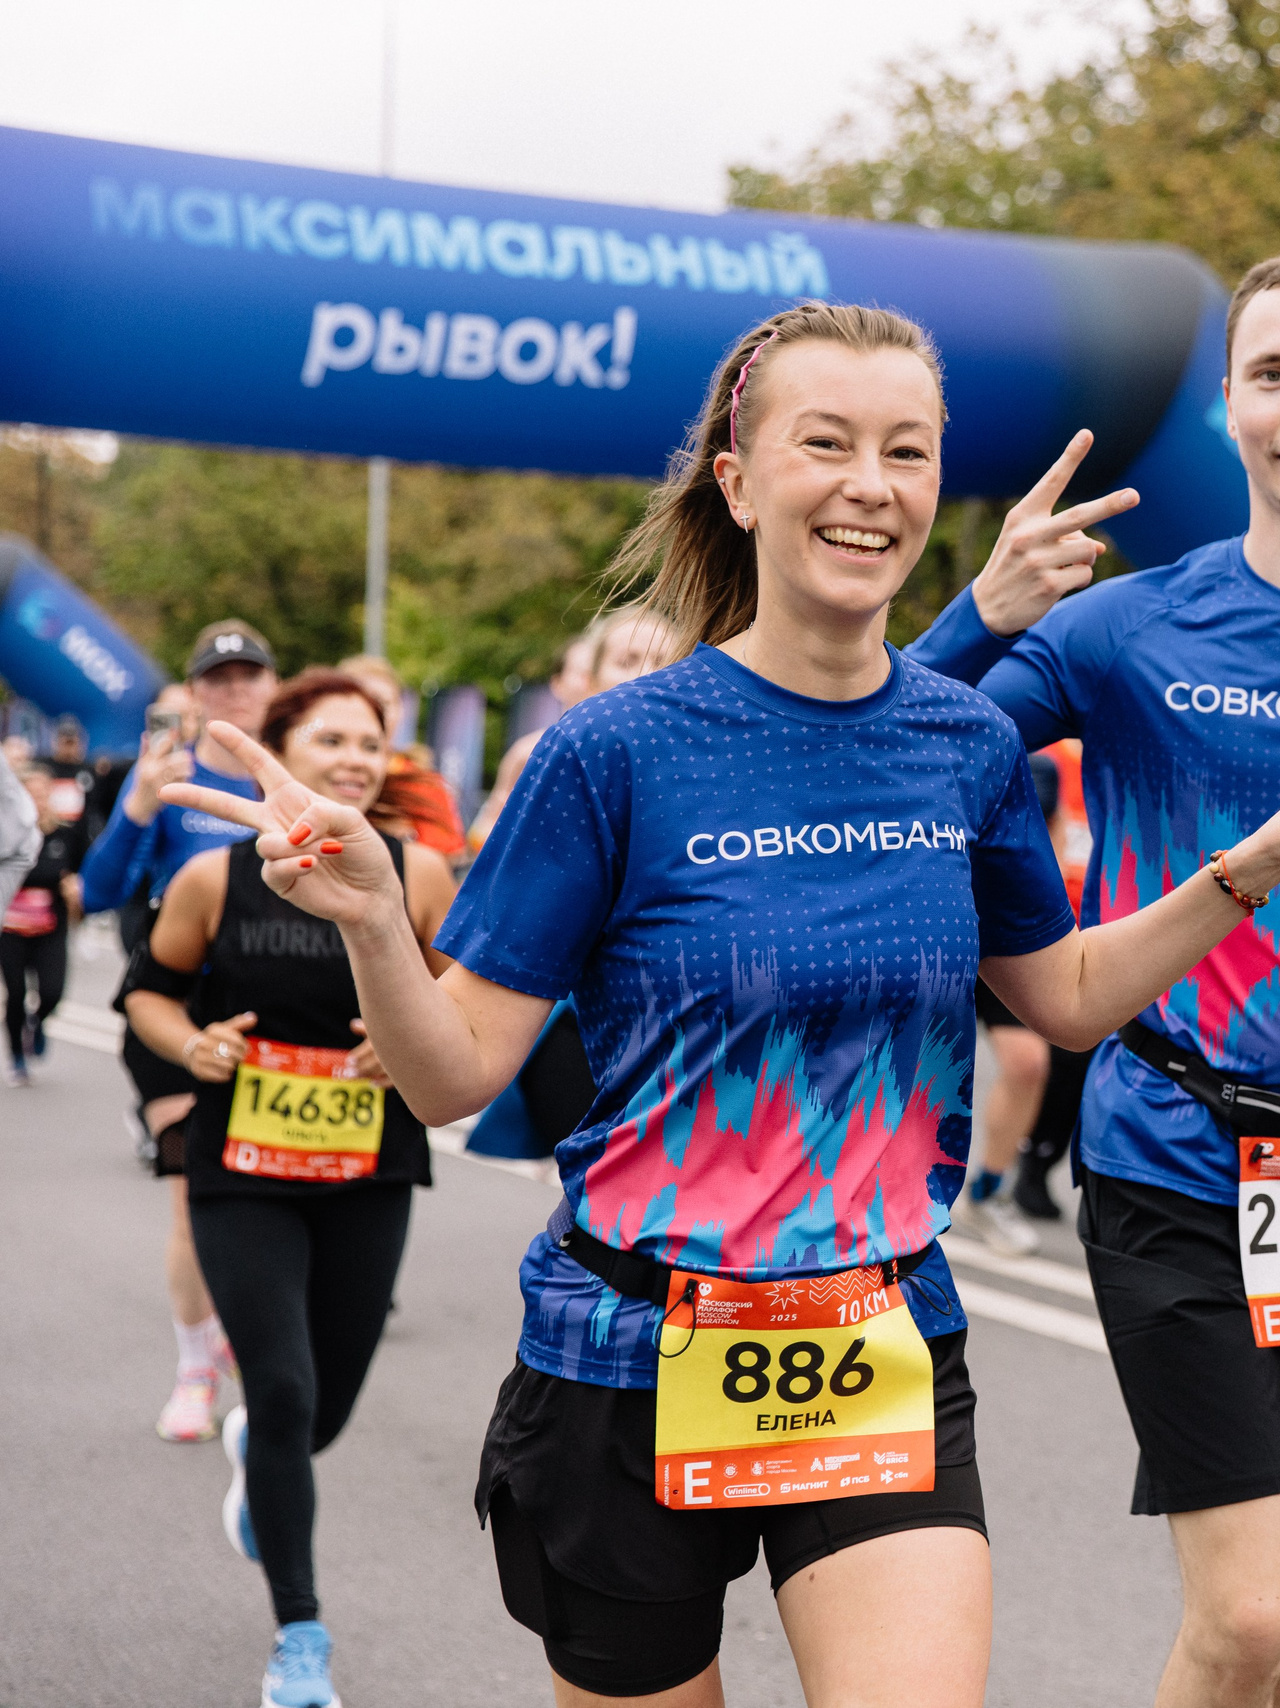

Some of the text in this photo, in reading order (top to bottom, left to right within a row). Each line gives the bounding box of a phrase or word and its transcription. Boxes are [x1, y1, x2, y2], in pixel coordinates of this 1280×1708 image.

[90, 174, 829, 298] максимальный
[303, 301, 637, 389] рывок!
[246, 1075, 375, 1127] 14638
[236, 1142, 260, 1172] D
[697, 1305, 737, 1313] МАРАФОН
[698, 1298, 753, 1308] МОСКОВСКИЙ
[770, 1314, 798, 1322] 2025
[837, 1300, 860, 1325] 10
[722, 1336, 874, 1404] 886
[756, 1409, 837, 1431] ЕЛЕНА
[886, 1456, 909, 1464] BRICS
[792, 1481, 829, 1491] МАГНИТ
[852, 1475, 870, 1484] ПСБ
[728, 1487, 758, 1495] Winline
